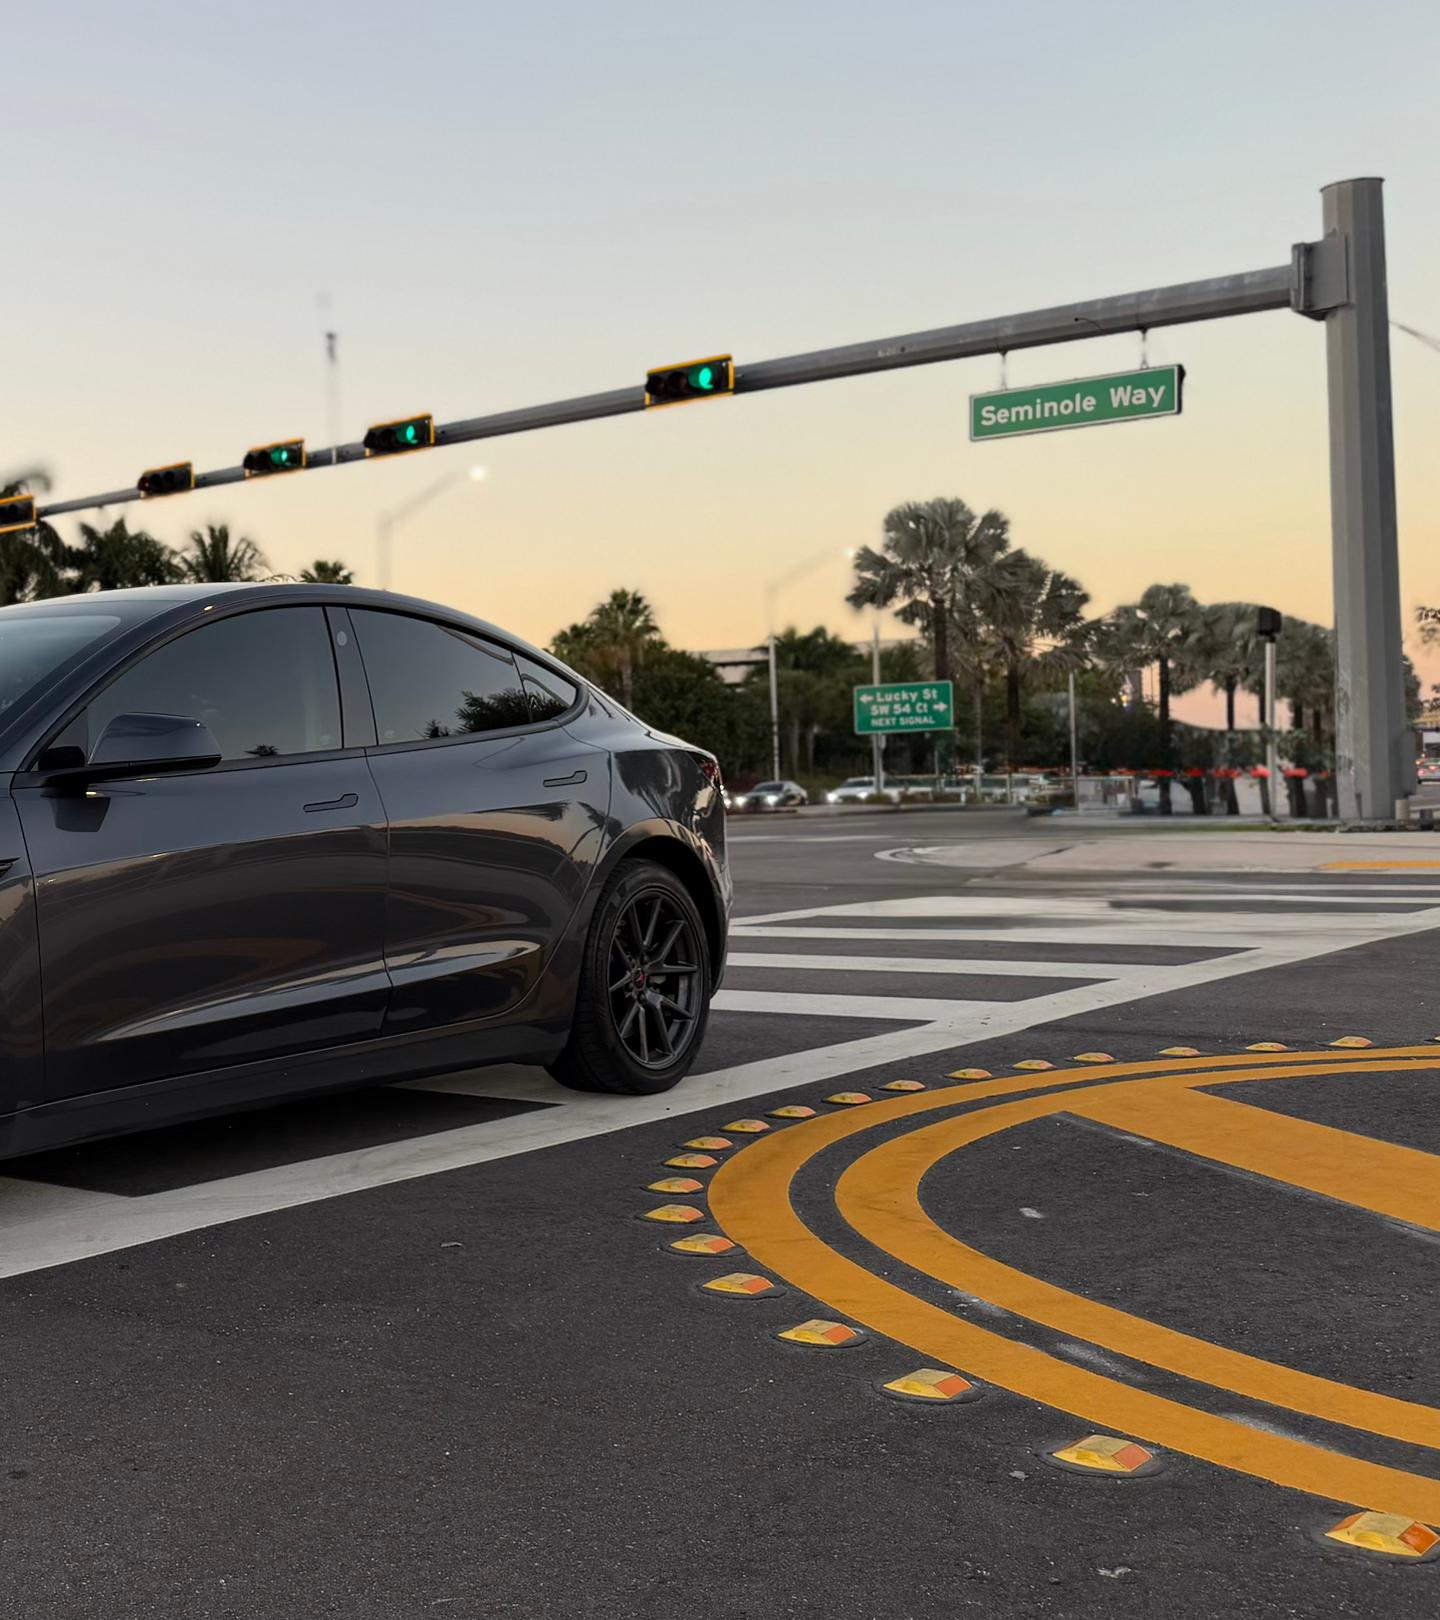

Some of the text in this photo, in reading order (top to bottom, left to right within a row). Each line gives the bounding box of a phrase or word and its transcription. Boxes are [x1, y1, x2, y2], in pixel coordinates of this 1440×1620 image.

[980, 385, 1166, 426] Seminole Way
[876, 688, 938, 702] Lucky St
[870, 702, 928, 716] SW 54 Ct
[871, 716, 935, 727] NEXT SIGNAL
